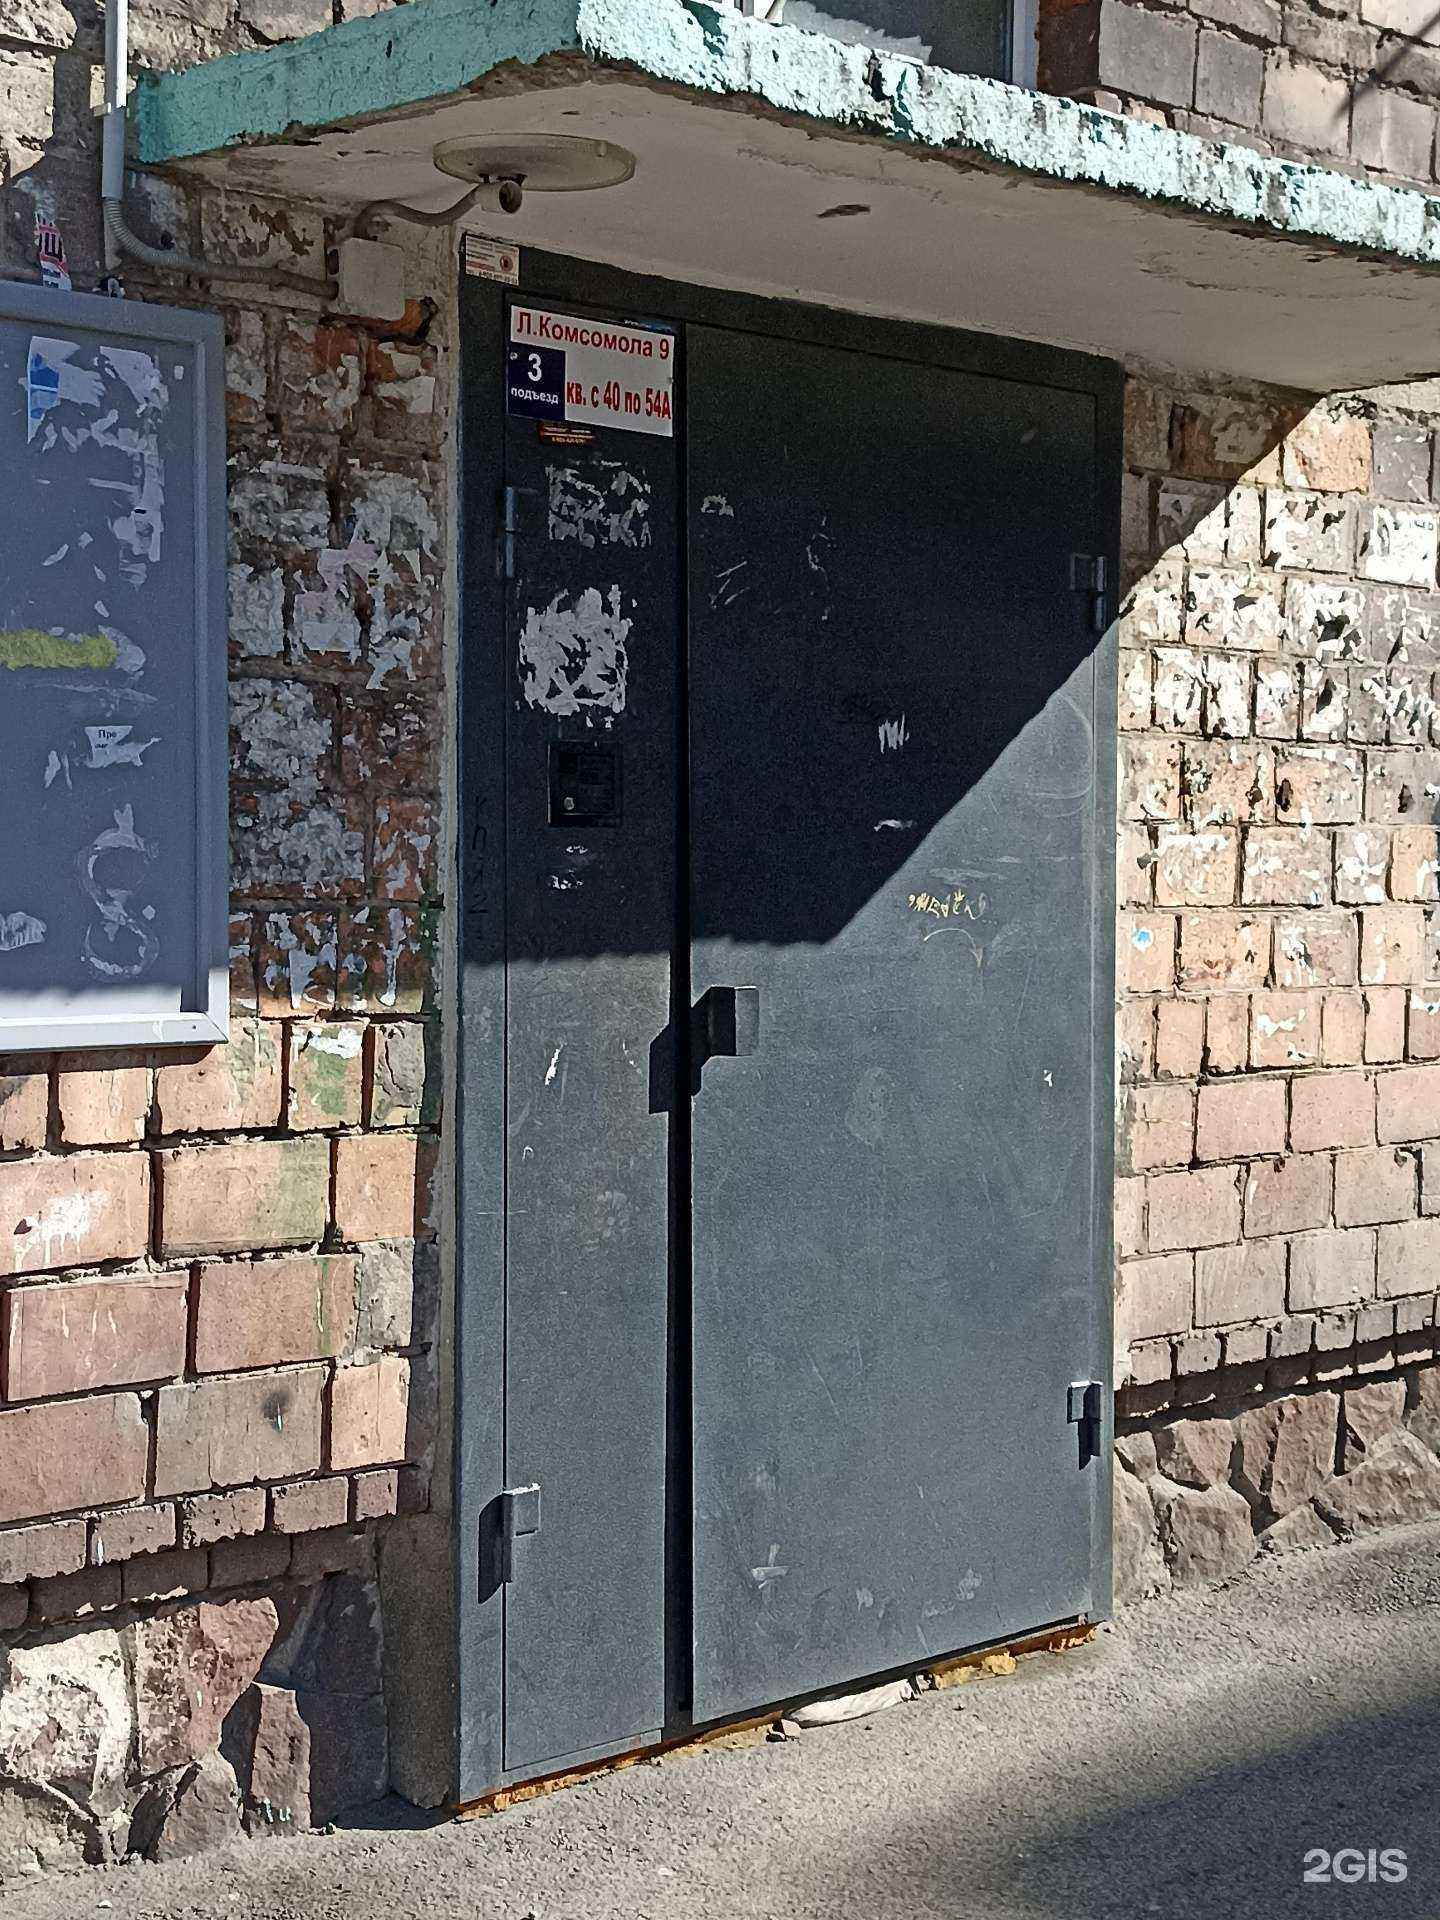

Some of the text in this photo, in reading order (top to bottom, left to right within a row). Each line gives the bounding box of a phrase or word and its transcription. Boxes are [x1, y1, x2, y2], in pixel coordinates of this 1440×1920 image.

[517, 312, 653, 357] Л.Комсомола
[660, 340, 670, 360] 9
[527, 353, 542, 382] 3
[510, 387, 559, 405] подъезд
[603, 381, 621, 412] 40
[625, 393, 640, 414] по
[646, 389, 672, 420] 54А
